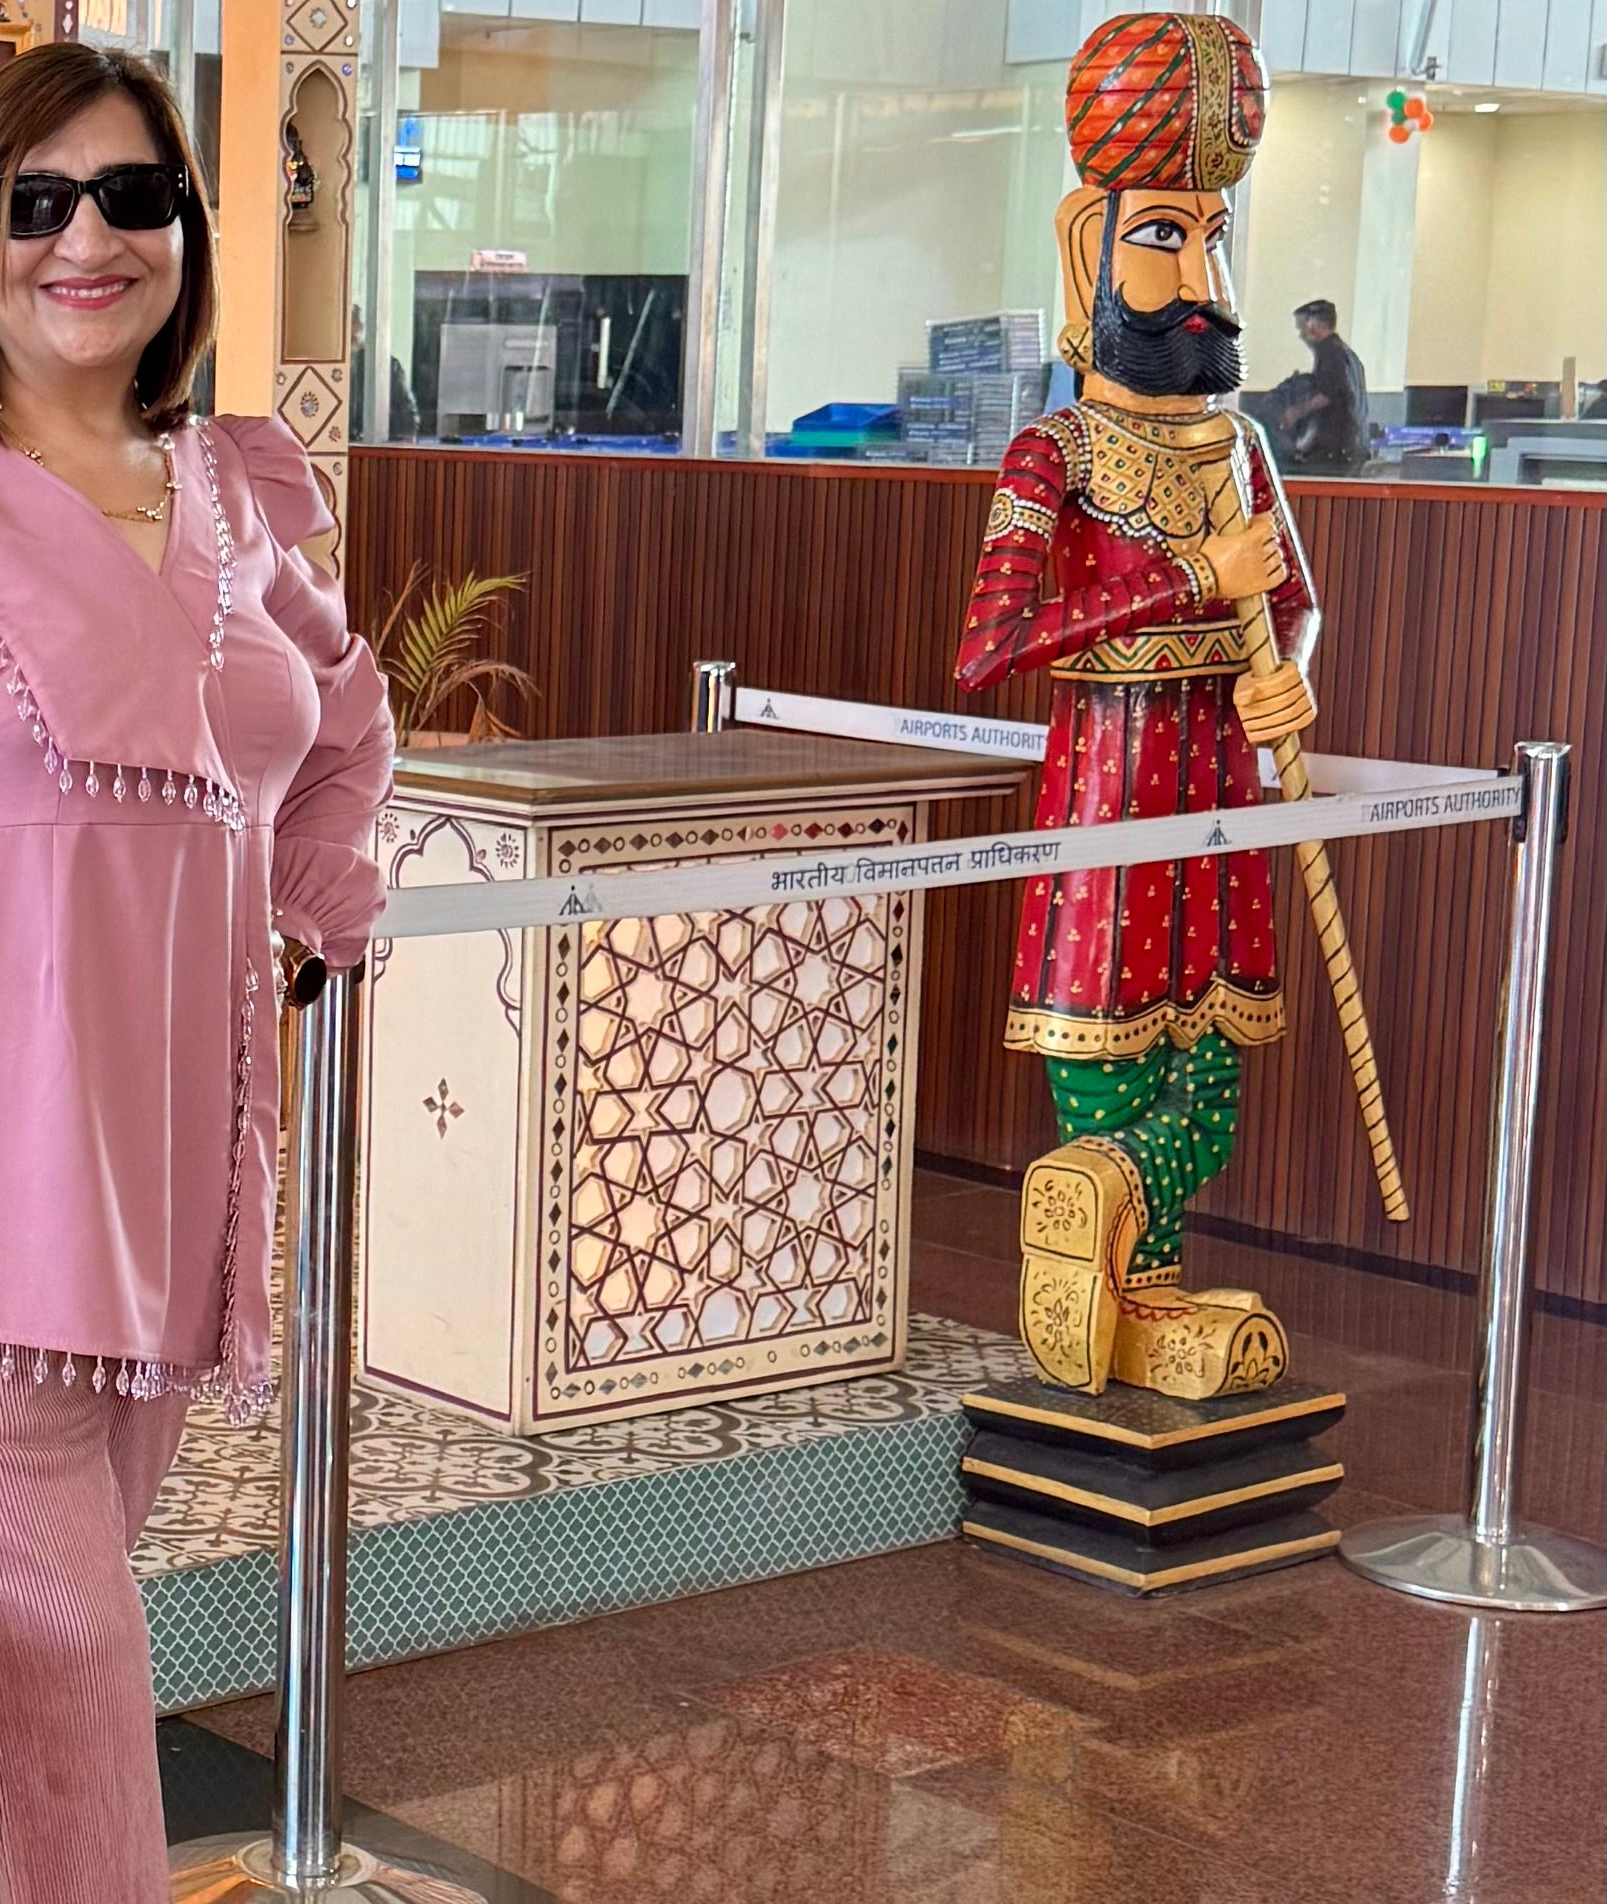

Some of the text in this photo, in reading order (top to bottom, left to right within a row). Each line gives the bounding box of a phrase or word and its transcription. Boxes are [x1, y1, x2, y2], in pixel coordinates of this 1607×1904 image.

[900, 718, 1047, 751] AIRPORTS AUTHORIT
[1369, 786, 1522, 823] AIRPORTS AUTHORITY
[770, 840, 1062, 891] भारतीय विमानपत्तन प्राधिकरण
